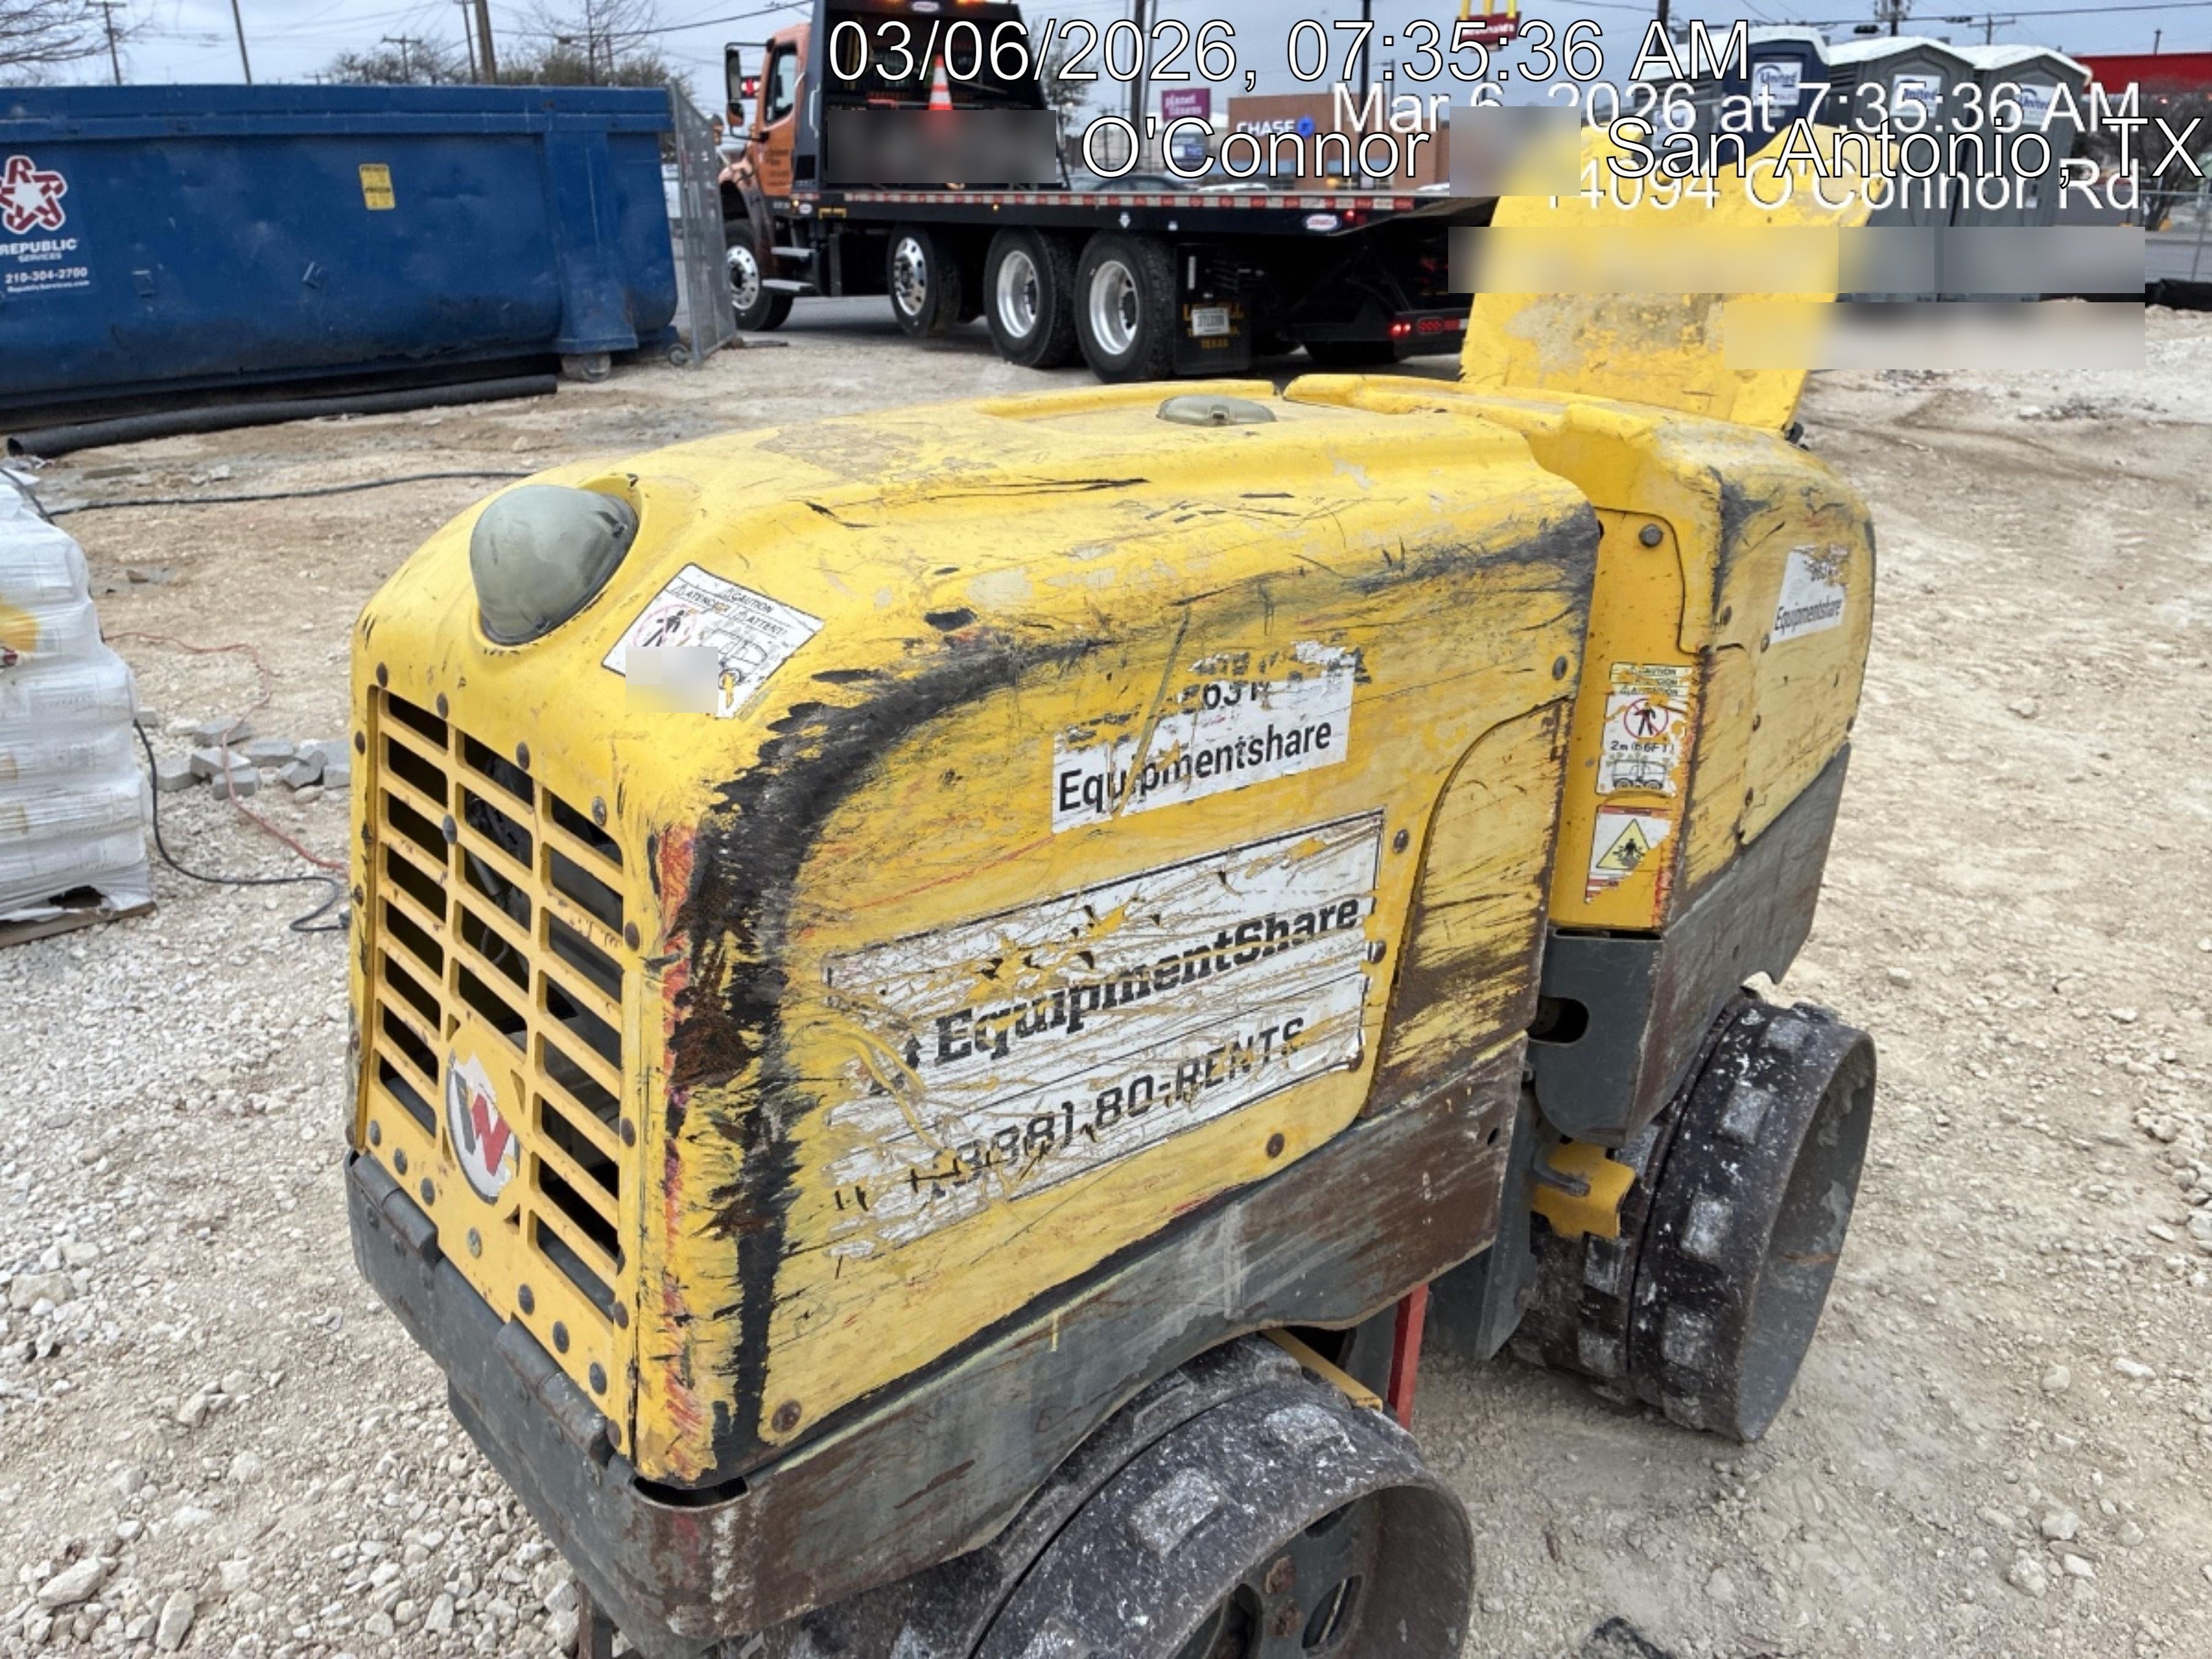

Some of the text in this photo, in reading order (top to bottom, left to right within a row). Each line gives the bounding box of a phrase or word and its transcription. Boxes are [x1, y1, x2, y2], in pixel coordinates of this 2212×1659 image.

[1236, 119, 1295, 136] CHASE
[0, 237, 77, 255] REPUBLIC
[1059, 721, 1332, 813] Equpmentshare
[935, 898, 1360, 1064] EquipmentShare
